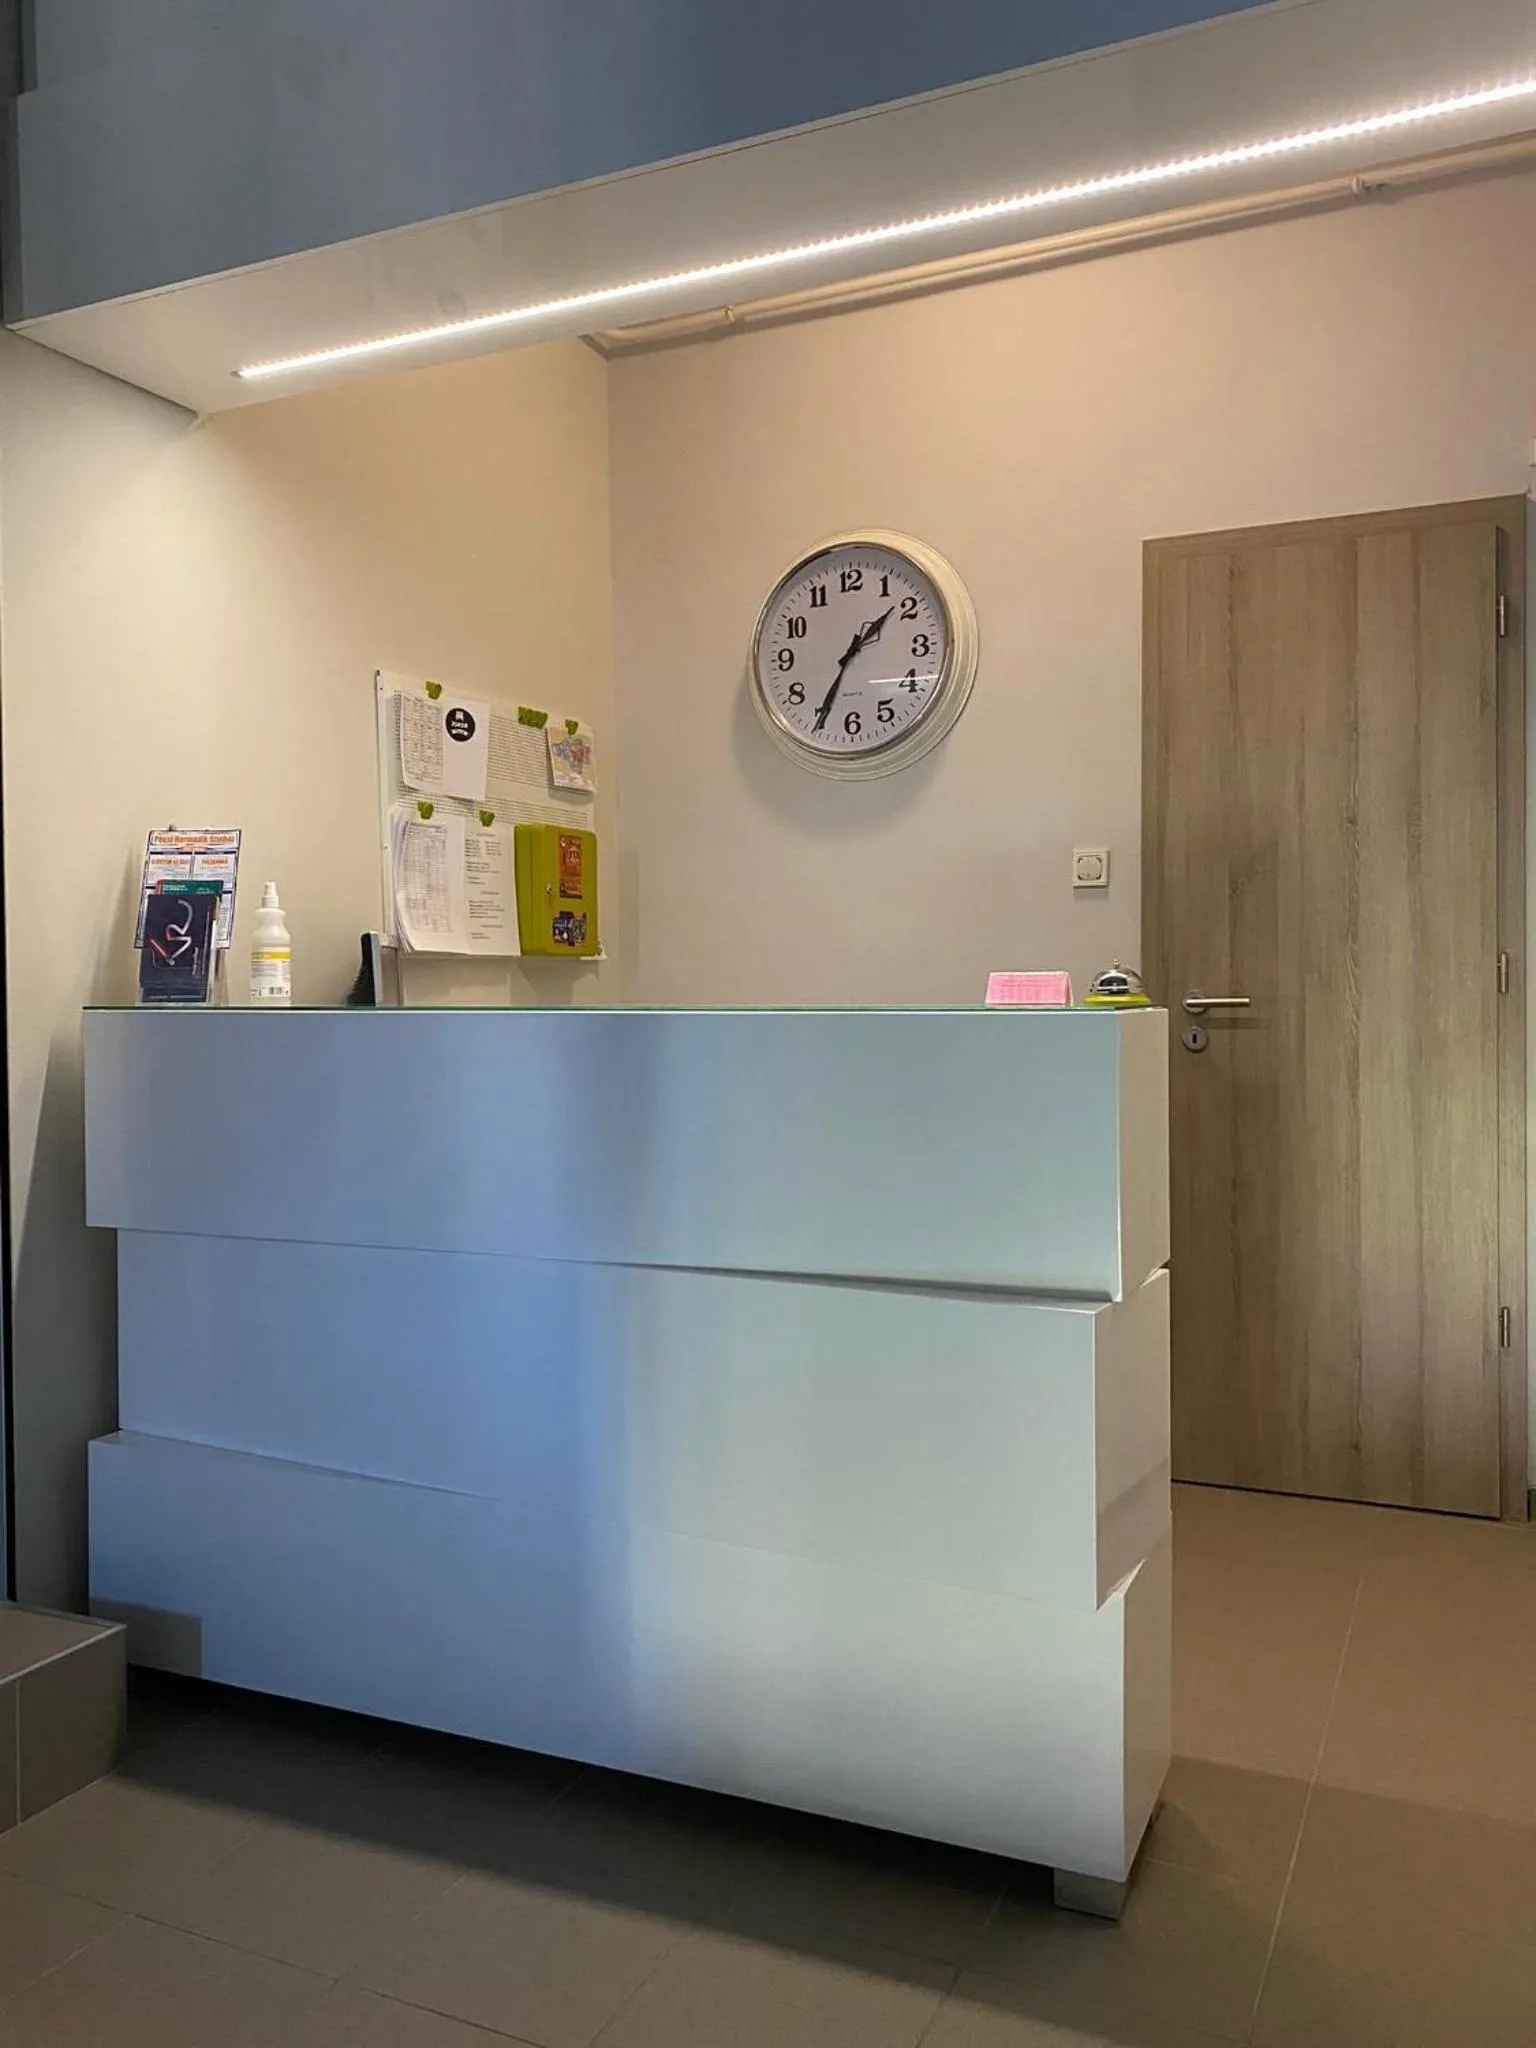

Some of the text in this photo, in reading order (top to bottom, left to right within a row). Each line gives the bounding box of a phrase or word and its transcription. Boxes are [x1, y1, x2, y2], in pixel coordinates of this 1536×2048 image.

[840, 569, 863, 593] 12
[879, 575, 890, 597] 1
[810, 585, 828, 608] 11
[900, 597, 918, 620] 2
[787, 616, 807, 639] 10
[911, 634, 930, 657] 3
[778, 648, 794, 671] 9
[899, 668, 918, 693] 4
[788, 682, 805, 705] 8
[815, 707, 831, 729] 7
[877, 698, 895, 723] 5
[844, 712, 861, 735] 6
